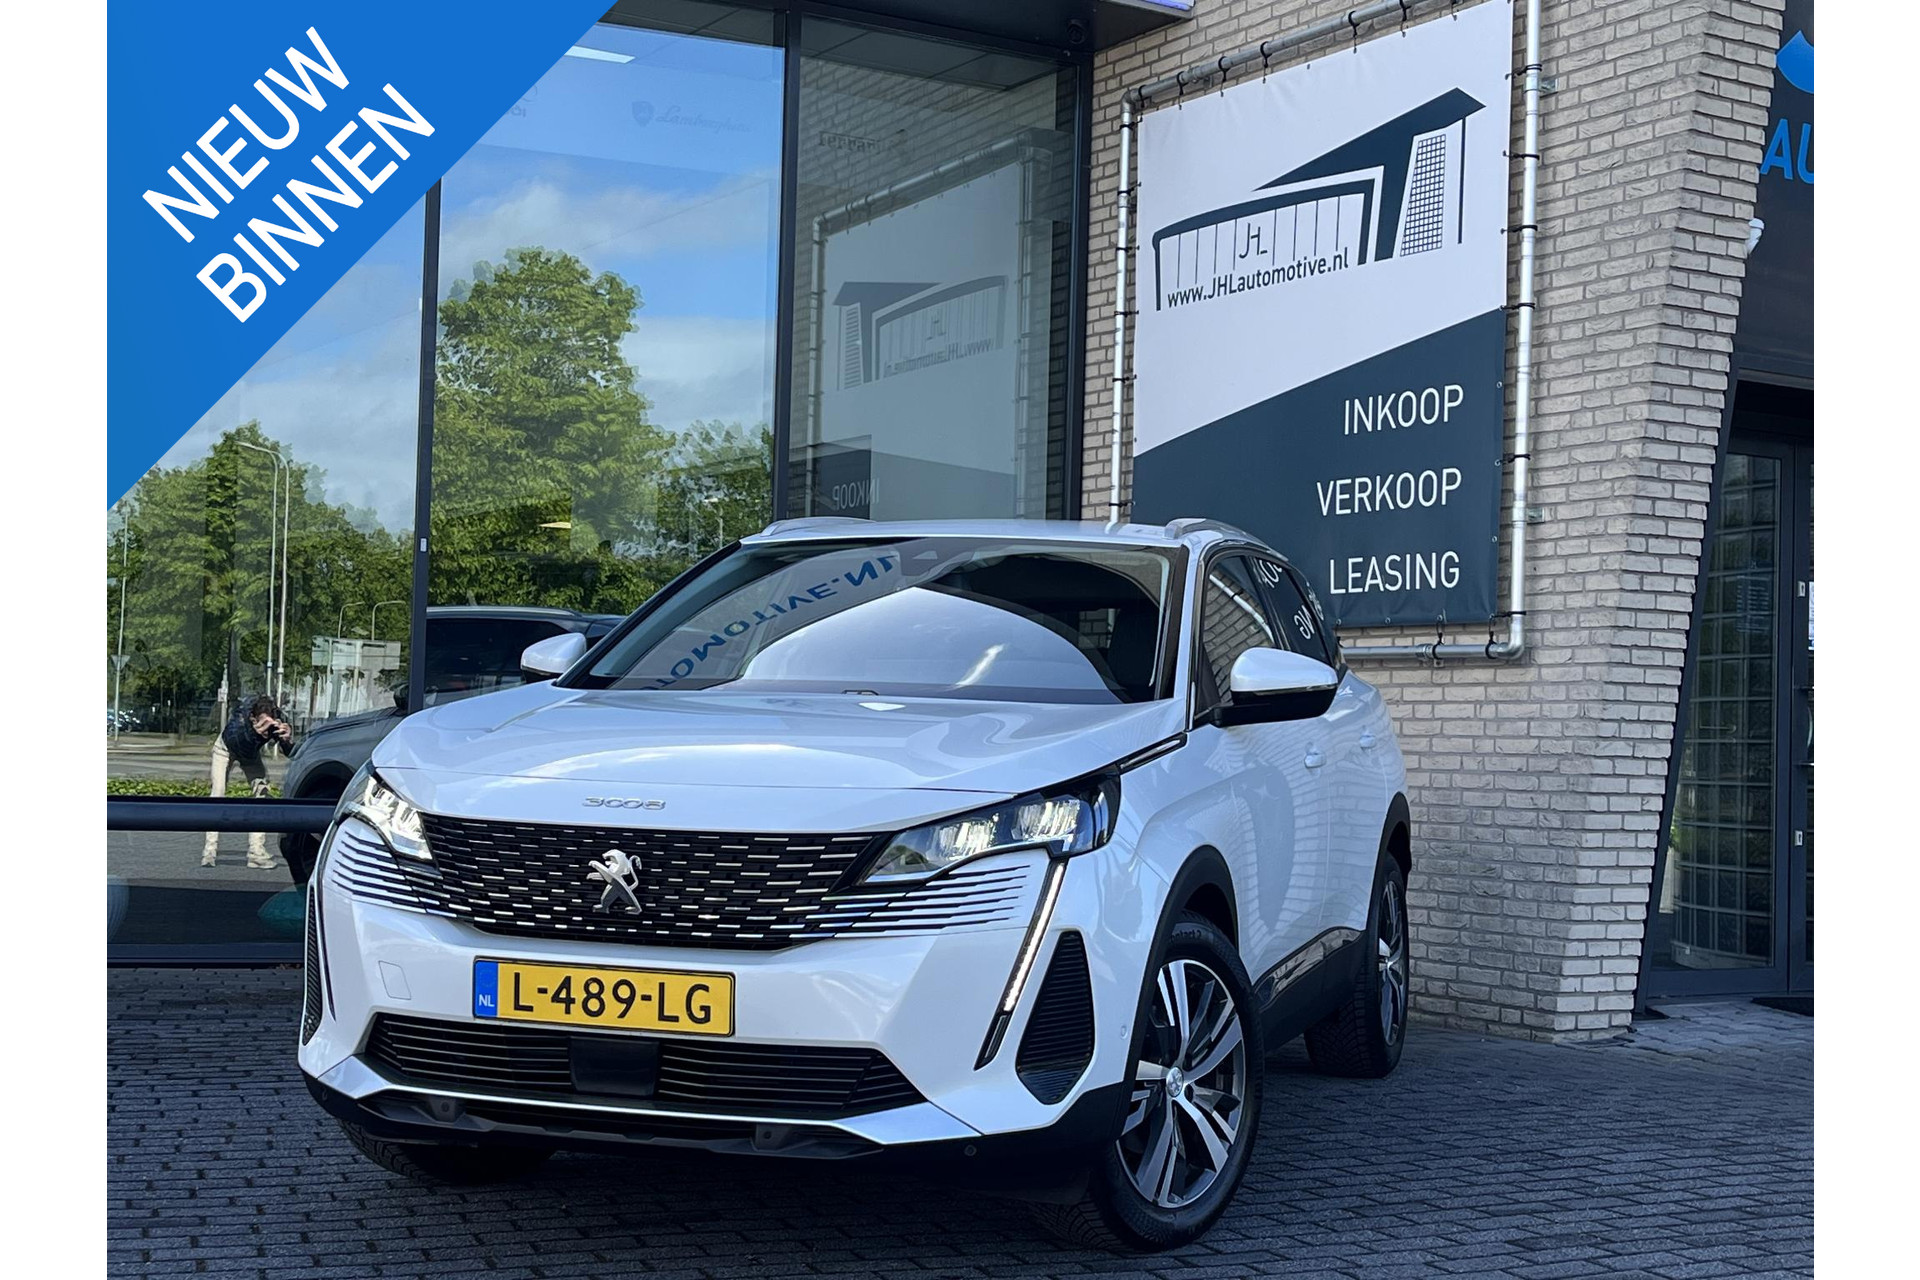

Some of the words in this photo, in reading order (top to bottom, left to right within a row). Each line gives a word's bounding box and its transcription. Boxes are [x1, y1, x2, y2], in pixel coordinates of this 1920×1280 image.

[1167, 246, 1349, 309] www.JHLautomotive.nl
[1343, 383, 1464, 436] INKOOP
[1316, 467, 1462, 516] VERKOOP
[1329, 550, 1460, 596] LEASING
[582, 796, 667, 811] 3008
[478, 995, 495, 1008] NL
[513, 971, 712, 1025] L-489-LG
